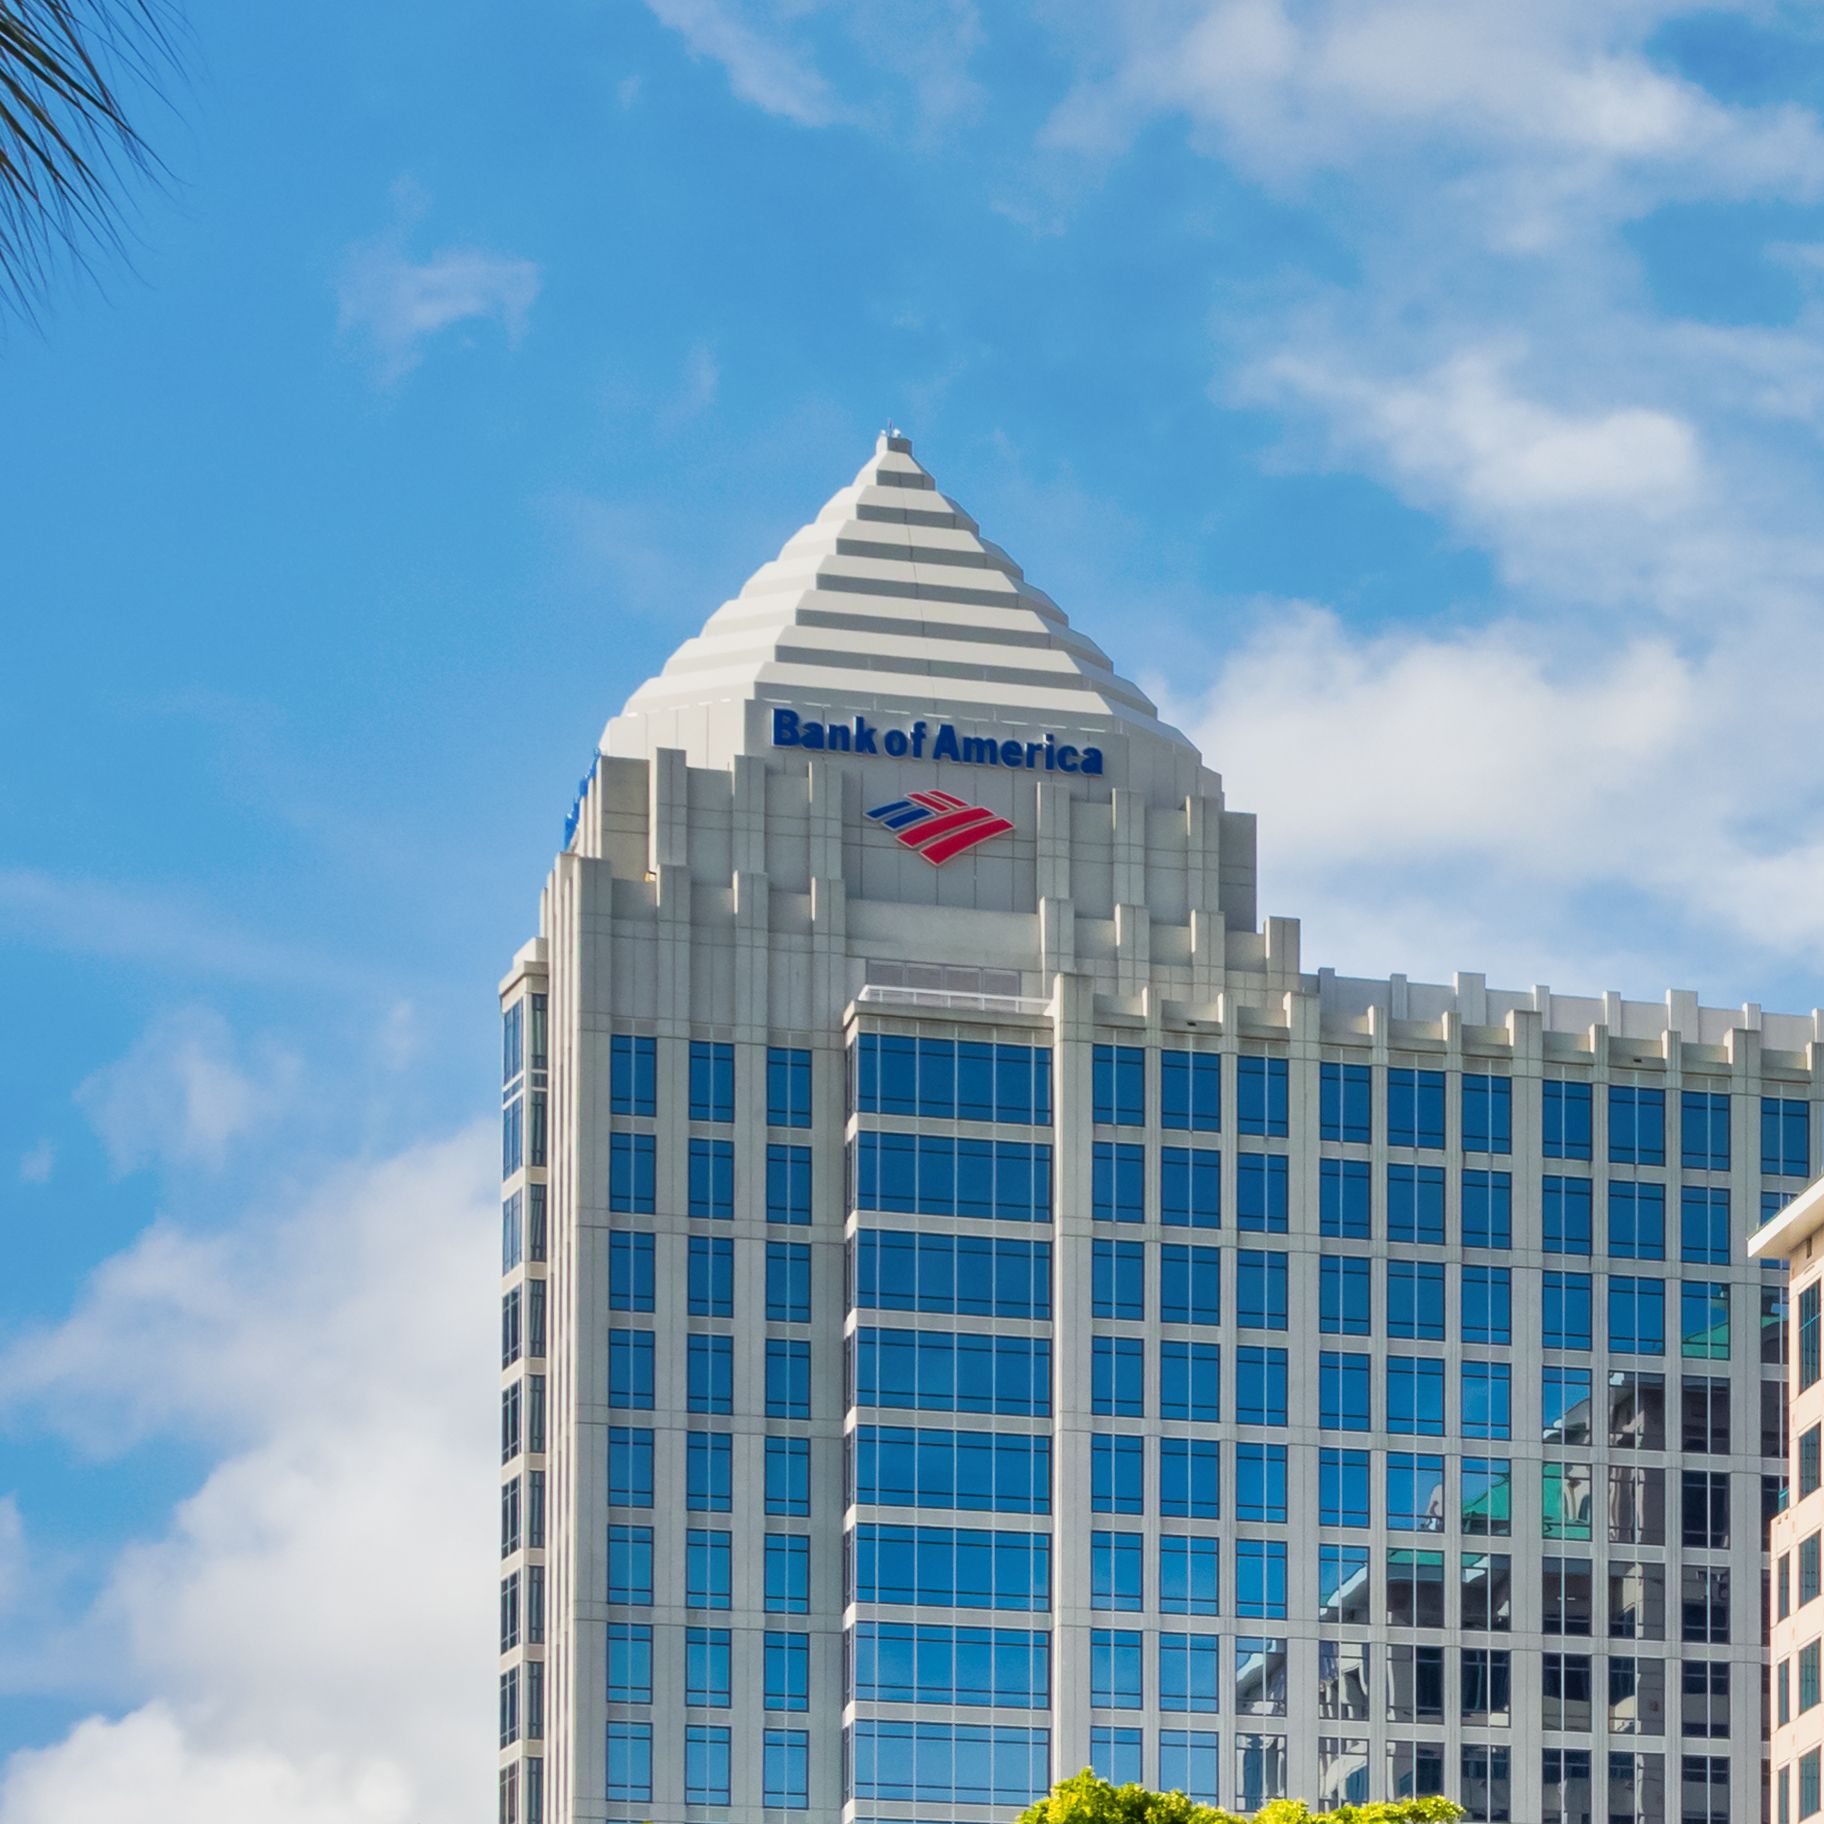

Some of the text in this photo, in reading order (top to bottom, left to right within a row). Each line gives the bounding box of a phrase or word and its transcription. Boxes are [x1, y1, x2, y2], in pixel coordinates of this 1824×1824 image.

[771, 708, 1104, 775] Bank of America
